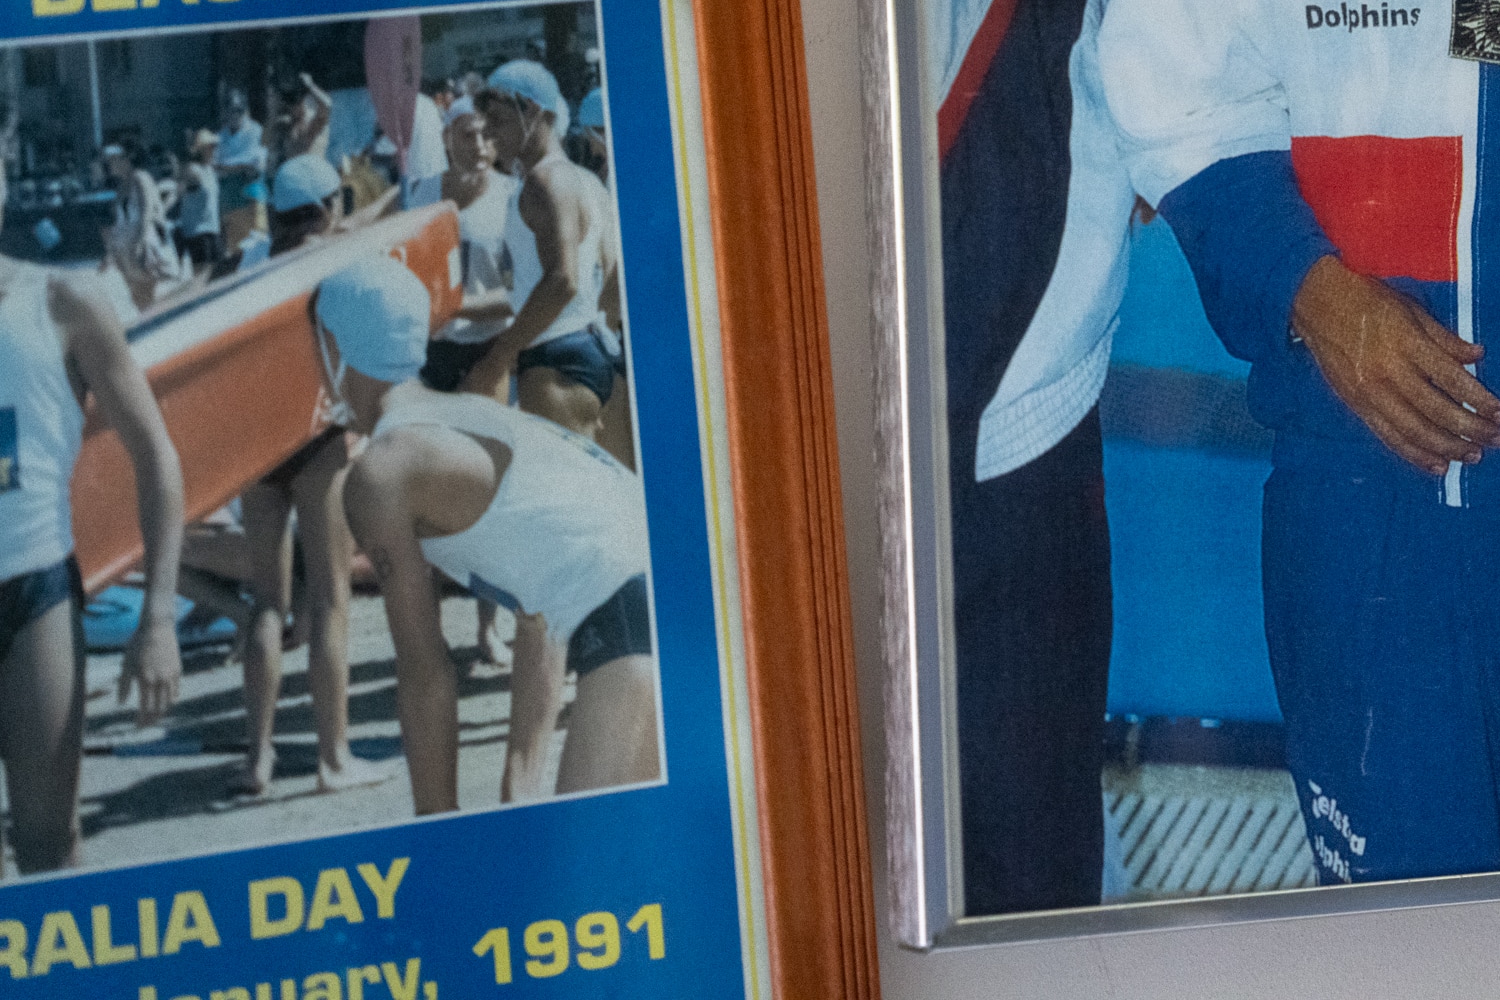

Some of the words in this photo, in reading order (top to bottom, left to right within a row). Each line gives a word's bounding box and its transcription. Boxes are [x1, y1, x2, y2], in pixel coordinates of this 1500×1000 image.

[1305, 1, 1421, 34] Dolphins
[248, 856, 411, 940] DAY
[472, 903, 667, 985] 1991
